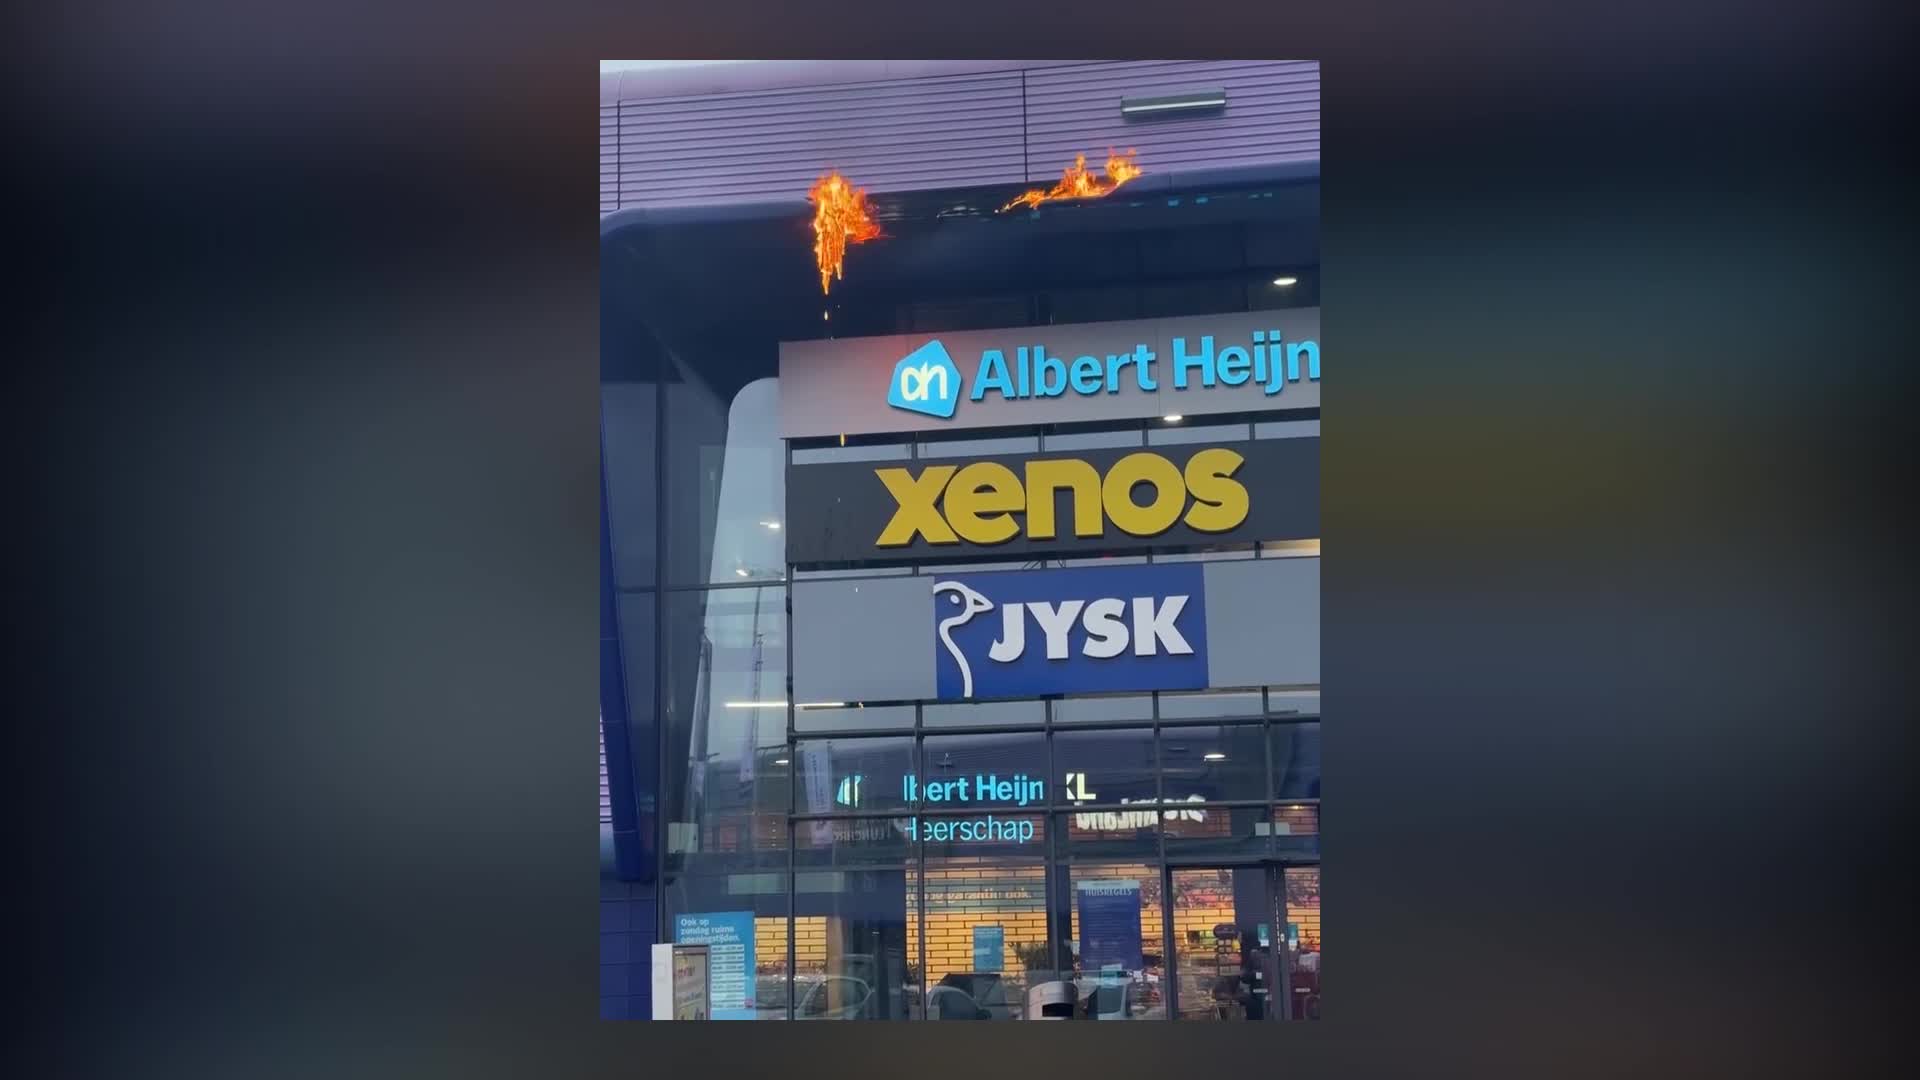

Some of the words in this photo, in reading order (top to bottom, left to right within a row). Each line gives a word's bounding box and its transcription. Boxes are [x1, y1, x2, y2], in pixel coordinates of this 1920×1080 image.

[970, 344, 1157, 401] Albert
[1172, 329, 1320, 397] Heijn
[873, 447, 1250, 549] xenos
[988, 594, 1194, 663] JYSK
[903, 772, 969, 802] lbert
[975, 773, 1044, 806] Heijn
[904, 815, 1034, 844] Heerschap
[680, 918, 696, 926] Ook
[699, 919, 709, 927] op
[681, 926, 709, 936] zondag
